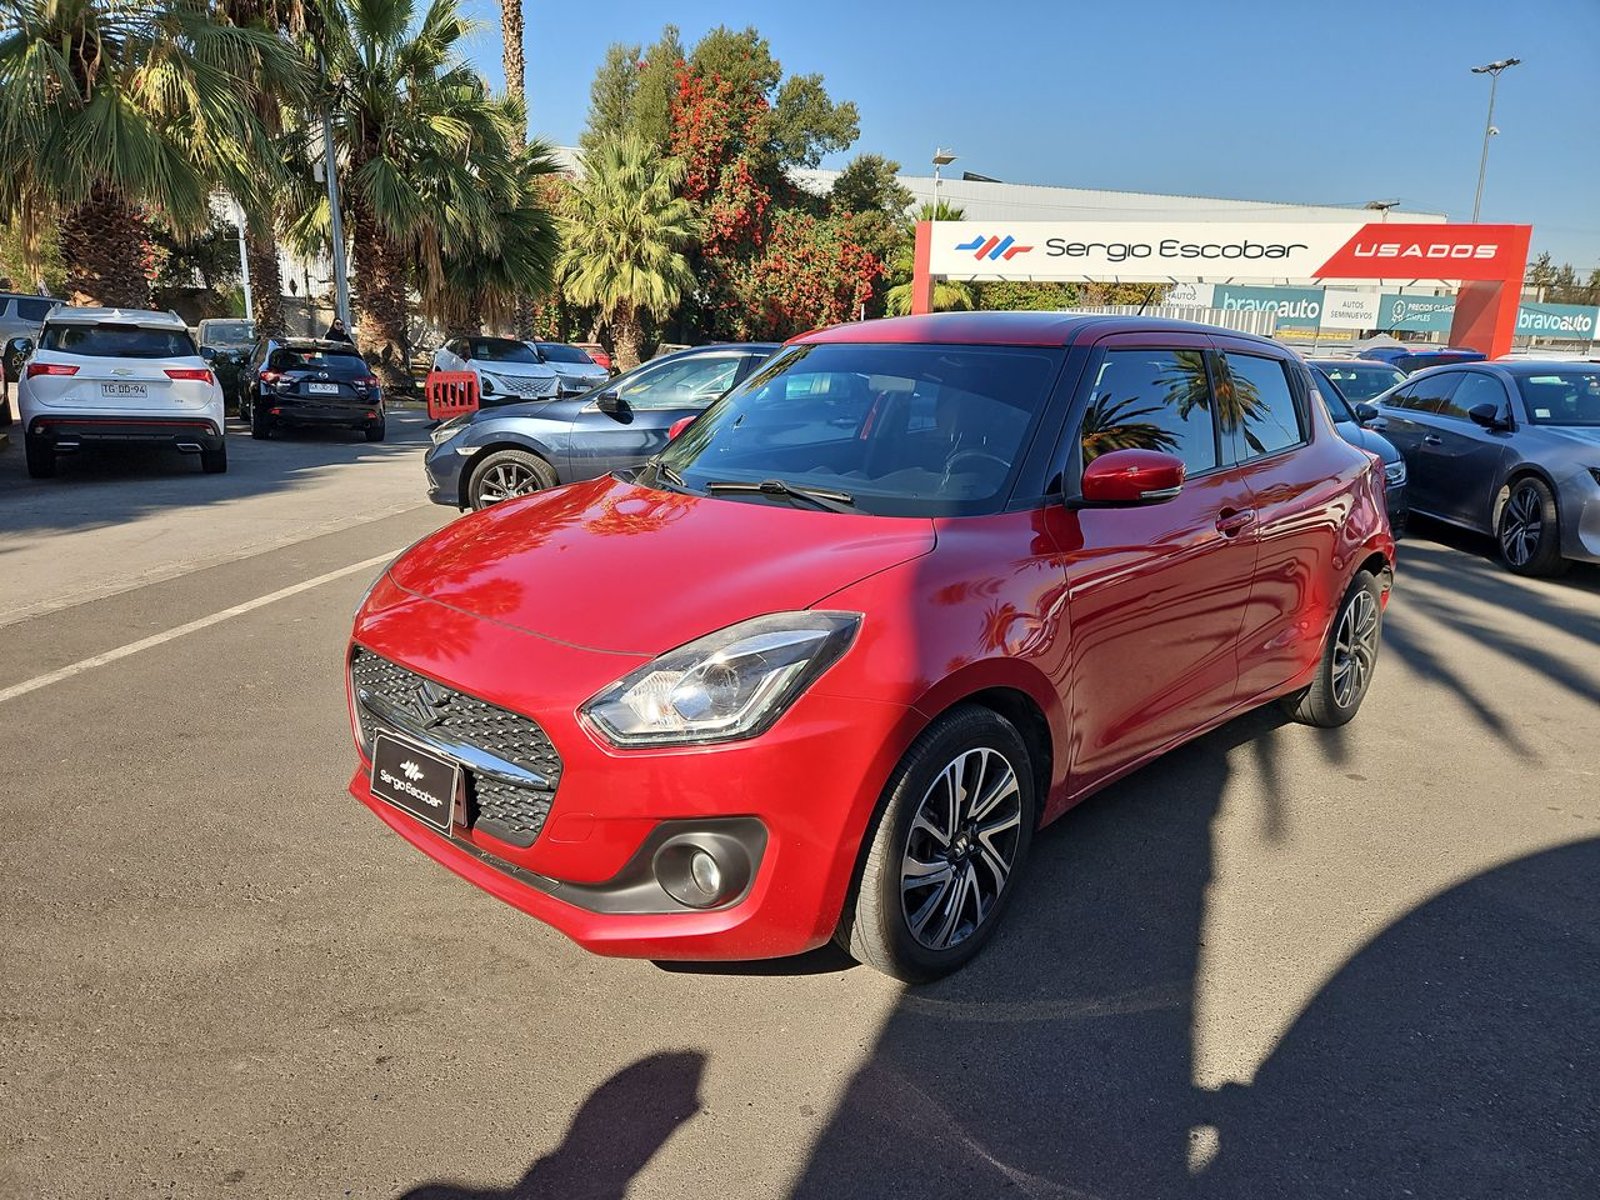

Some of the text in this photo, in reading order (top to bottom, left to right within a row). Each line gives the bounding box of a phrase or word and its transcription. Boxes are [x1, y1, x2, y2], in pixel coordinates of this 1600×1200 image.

[1046, 238, 1309, 262] Sergio Escobar
[1354, 243, 1498, 259] USADOS
[1223, 292, 1320, 319] bravoauto
[1342, 301, 1364, 309] AUTOS
[1407, 303, 1456, 312] PRECIOS CLARO
[1330, 311, 1373, 320] SEMINUEVOS
[1518, 308, 1592, 332] bravoauto
[405, 782, 443, 808] Escobar
